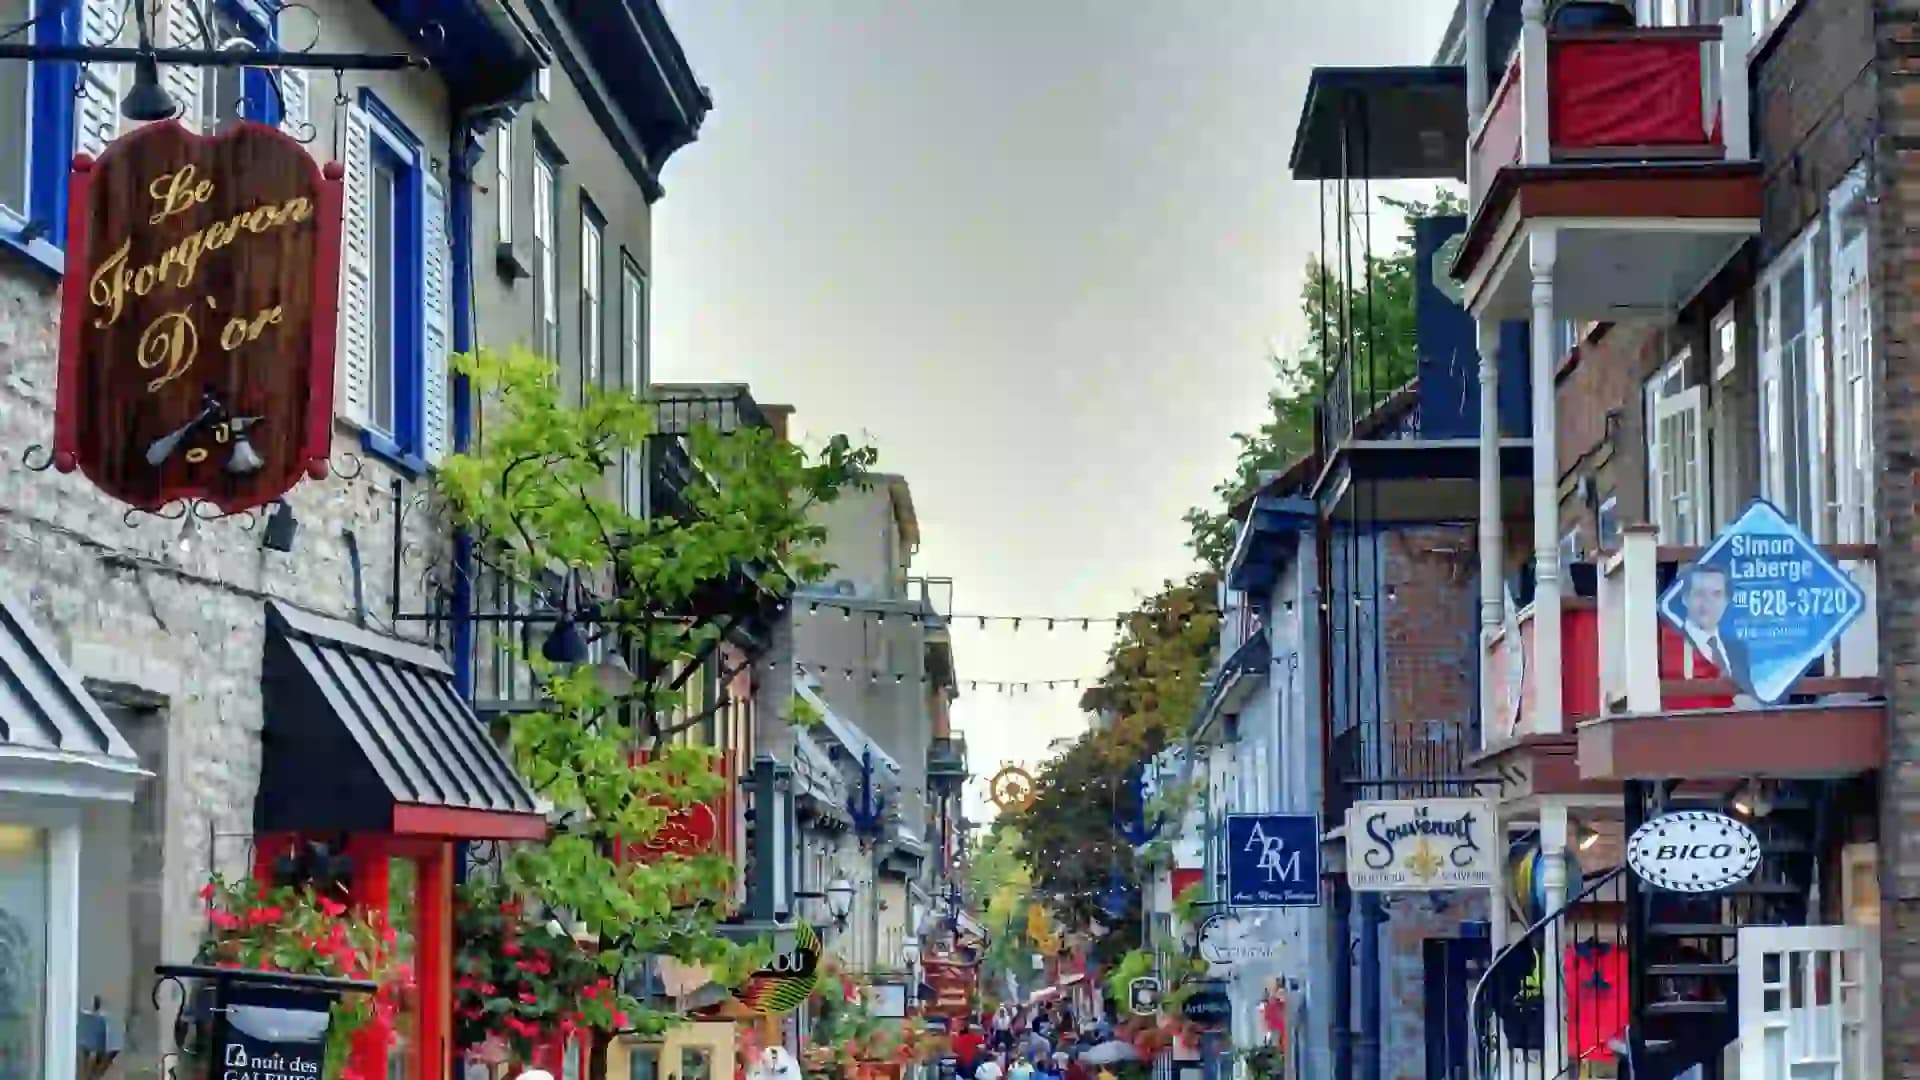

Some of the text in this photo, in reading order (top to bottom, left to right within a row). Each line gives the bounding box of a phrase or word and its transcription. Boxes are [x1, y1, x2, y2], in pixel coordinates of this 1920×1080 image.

[149, 164, 215, 225] Le
[90, 195, 314, 329] Forgeron
[1731, 535, 1795, 556] Simon
[1731, 558, 1813, 582] Laberge
[1656, 844, 1732, 860] BICO
[251, 1051, 285, 1071] nuit
[289, 1056, 318, 1073] des
